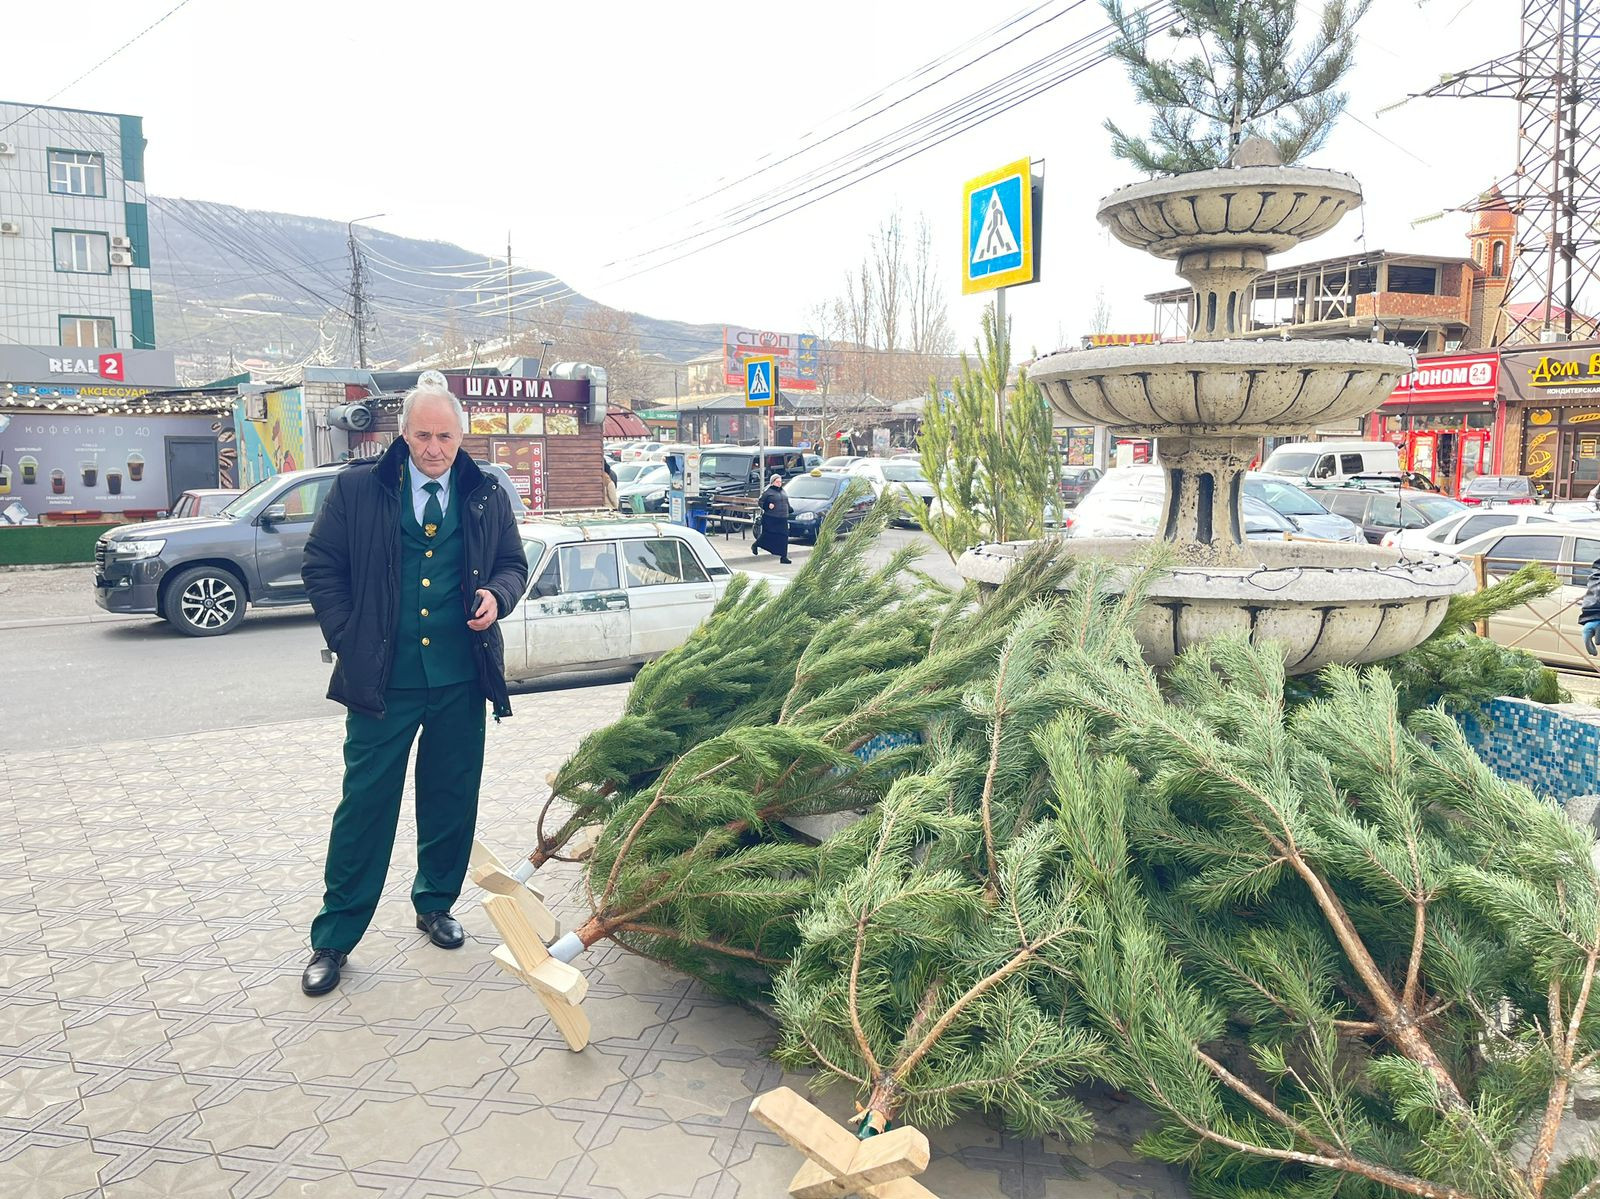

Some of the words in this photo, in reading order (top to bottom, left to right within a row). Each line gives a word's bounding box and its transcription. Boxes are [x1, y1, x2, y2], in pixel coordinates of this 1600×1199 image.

[49, 358, 98, 374] REAL
[104, 357, 118, 375] 2
[1530, 356, 1579, 382] Дом
[466, 377, 553, 398] ШАУРМА
[1397, 367, 1468, 388] ТРОНОМ
[1472, 367, 1486, 376] 24
[114, 426, 124, 437] D
[135, 427, 150, 438] 40
